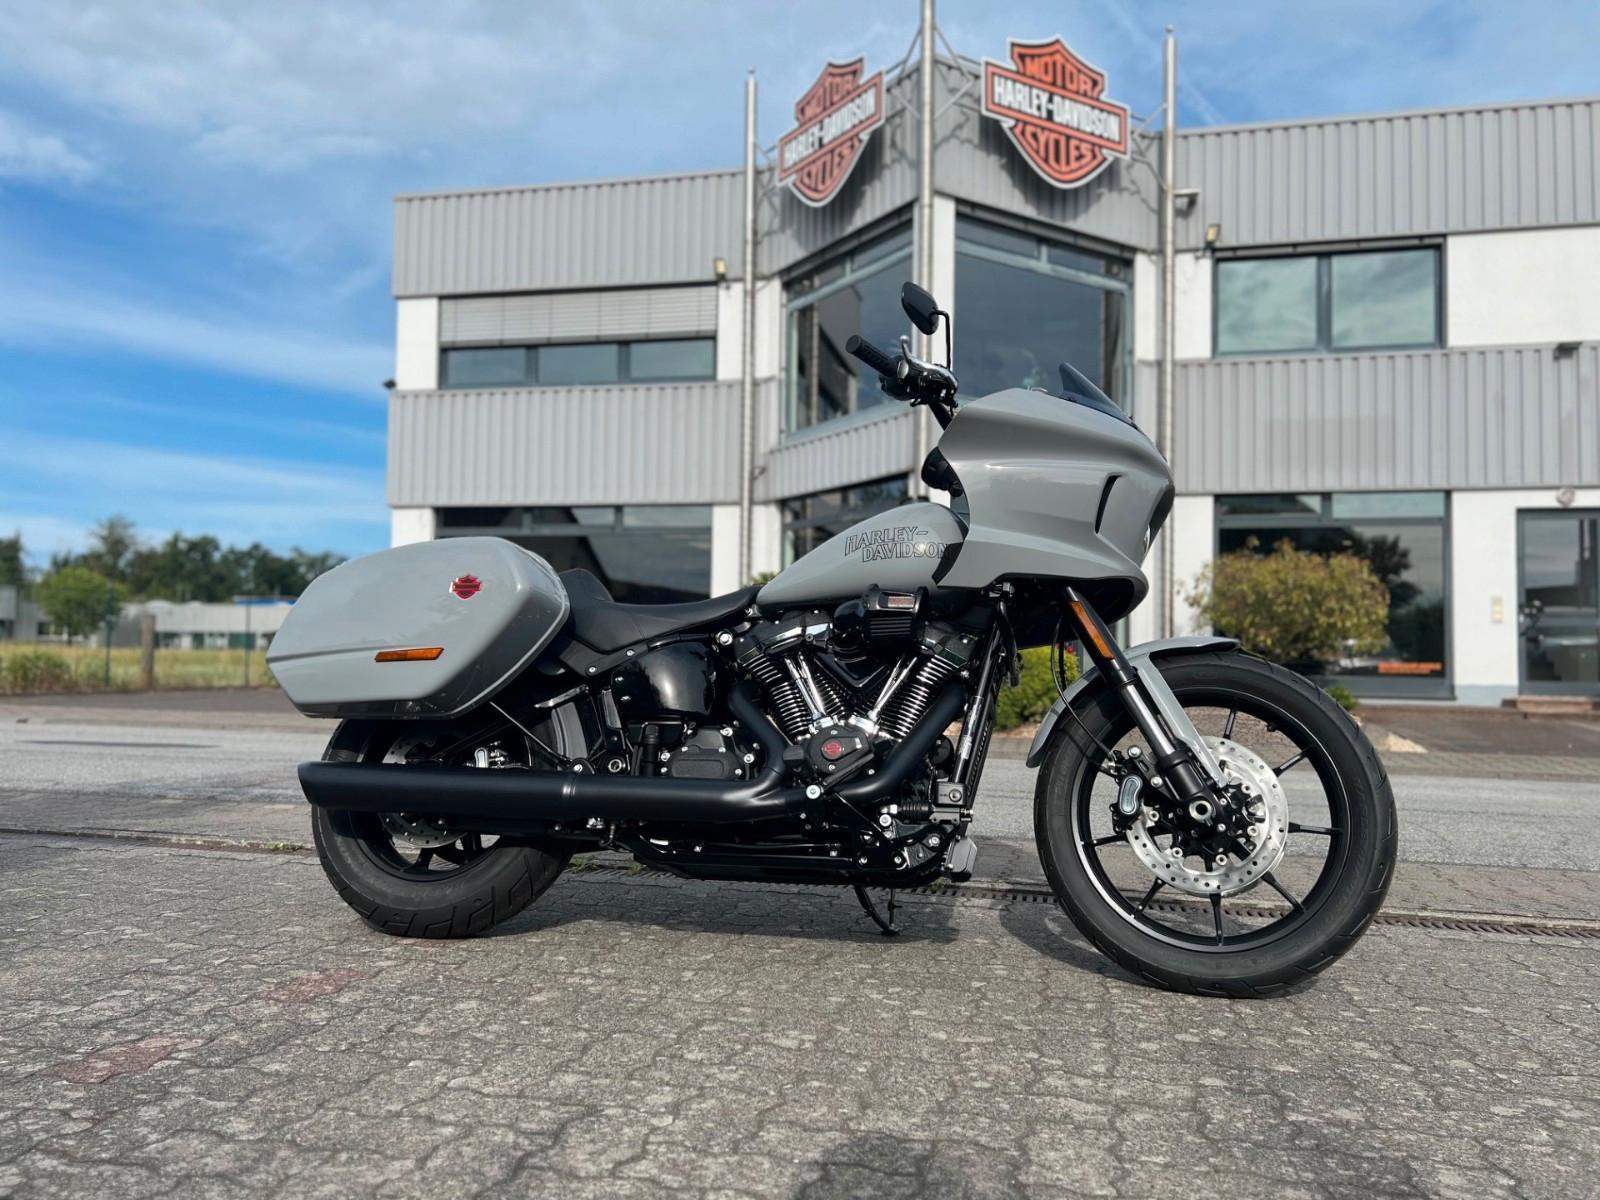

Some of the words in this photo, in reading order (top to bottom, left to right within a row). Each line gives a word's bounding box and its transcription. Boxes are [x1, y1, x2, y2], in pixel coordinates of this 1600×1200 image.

[1022, 53, 1094, 97] MOTOR
[993, 74, 1121, 142] HARLEY-DAVIDSON
[1024, 123, 1094, 171] CYCLES
[845, 526, 928, 556] HARLEY-
